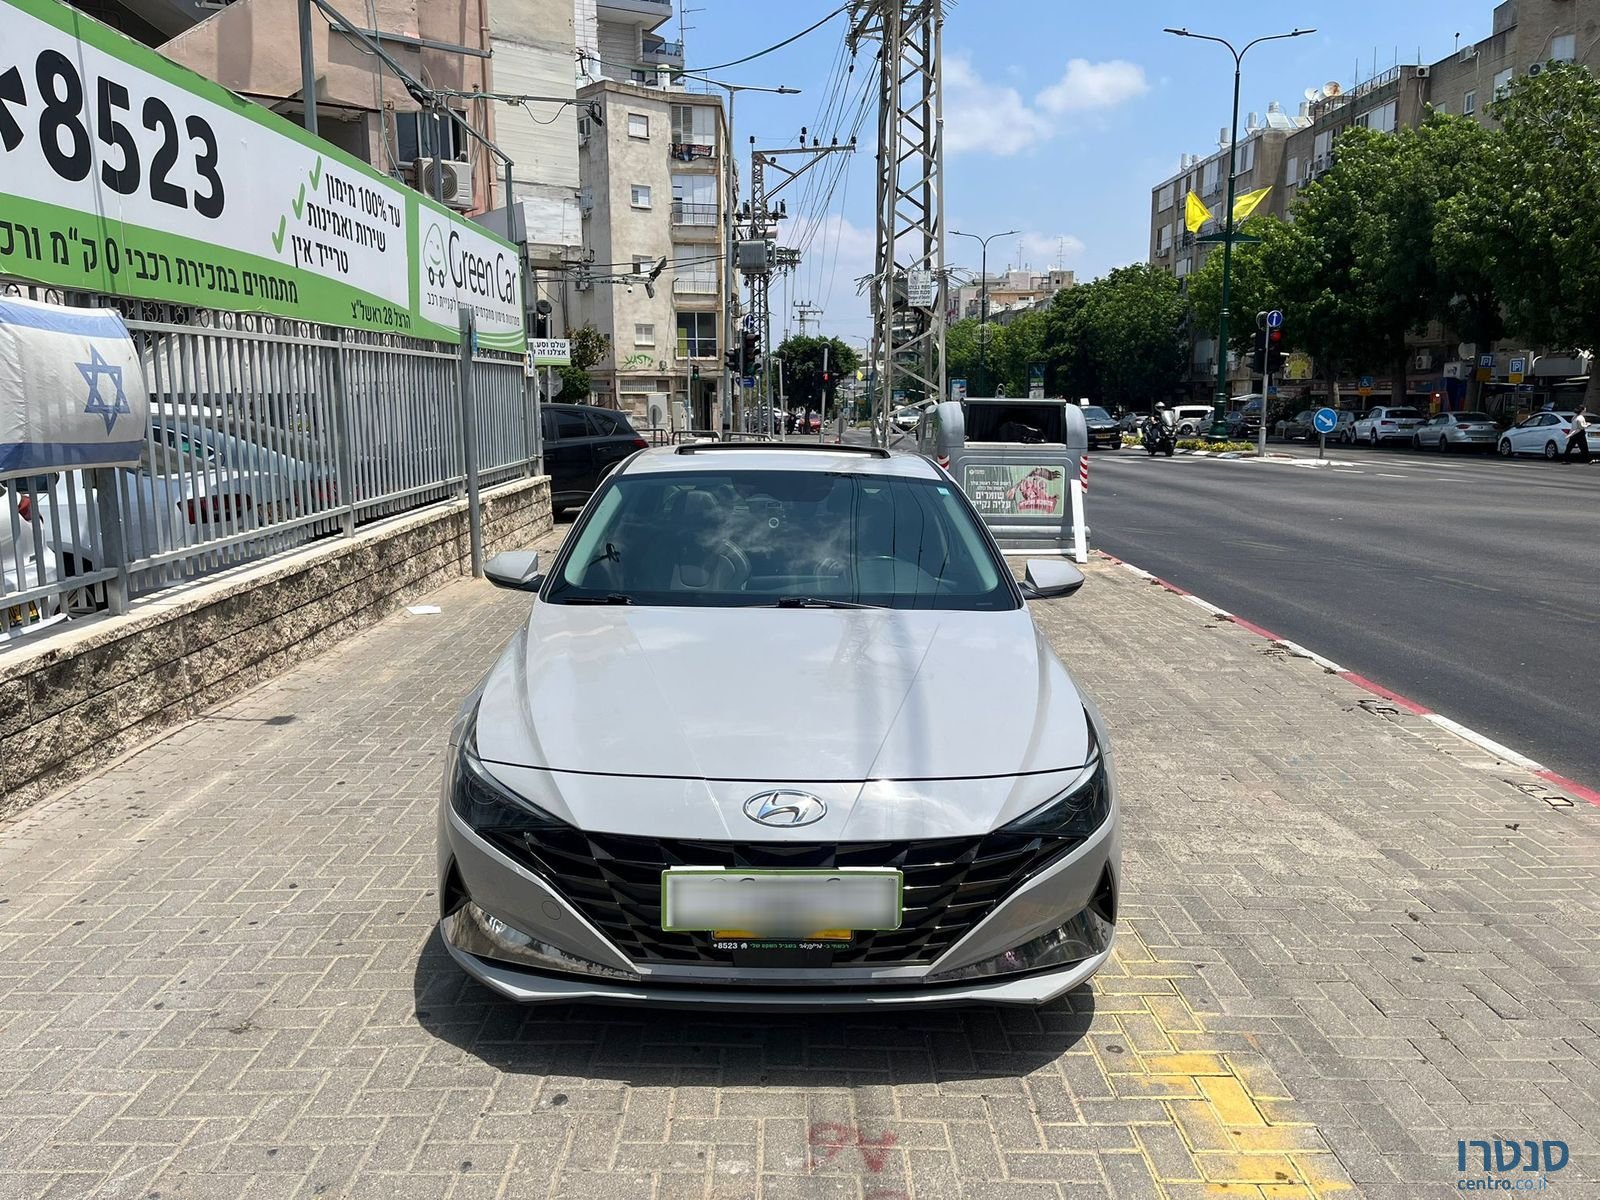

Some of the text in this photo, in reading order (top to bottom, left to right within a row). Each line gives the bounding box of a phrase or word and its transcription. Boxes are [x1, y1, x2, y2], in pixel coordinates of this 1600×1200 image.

[325, 173, 400, 228] עד 100% מימון
[307, 202, 386, 252] שירות ואמינות
[105, 237, 120, 275] 0
[125, 247, 172, 283] רכבי
[292, 235, 349, 274] טרייד אין
[448, 230, 517, 305] Green Car
[175, 258, 240, 294] במכירת
[243, 271, 299, 304] מתמחים
[382, 306, 394, 325] 28
[427, 292, 438, 306] רכב
[394, 308, 411, 329] הרצל
[550, 340, 566, 348] שלם
[976, 492, 1004, 500] שומרים
[992, 500, 1011, 508] עליה
